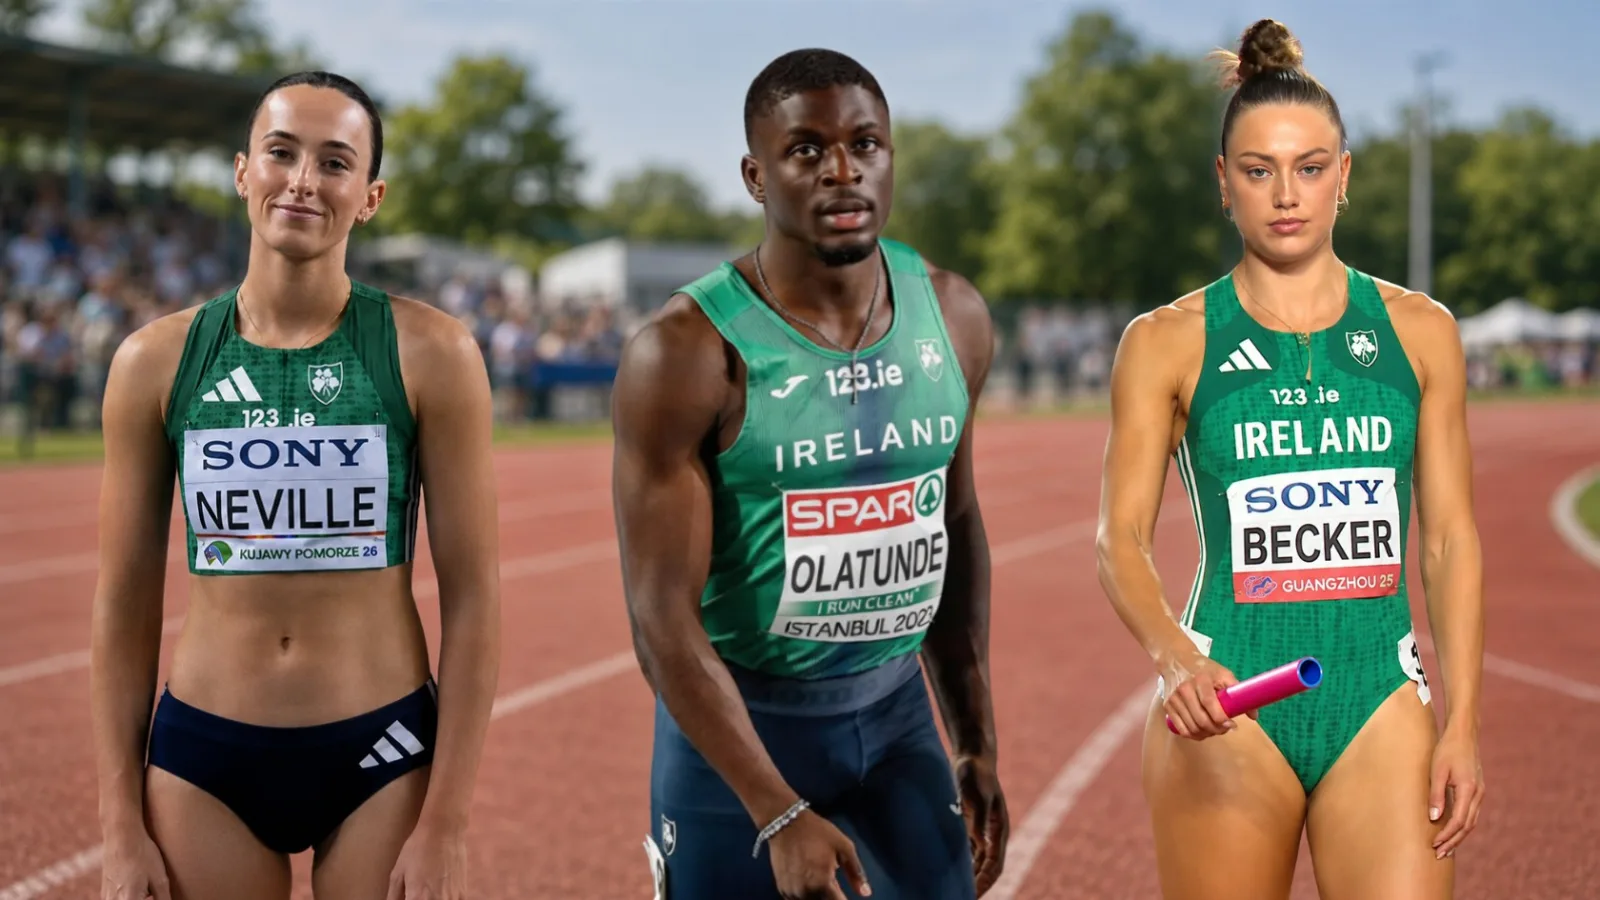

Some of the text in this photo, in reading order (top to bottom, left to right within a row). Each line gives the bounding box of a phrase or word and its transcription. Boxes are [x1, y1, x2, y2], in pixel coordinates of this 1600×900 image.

[202, 439, 369, 470] SONY
[776, 415, 957, 472] IRELAND
[1234, 416, 1392, 460] IRELAND
[196, 487, 376, 530] NEVILLE
[791, 489, 912, 530] SPAR
[1245, 480, 1384, 513] SONY
[239, 546, 378, 561] KUJAWY POMORZE 26
[1243, 520, 1394, 565] BECKER
[790, 531, 944, 594] OLATUNDE
[1282, 574, 1394, 593] GUANGZHOU 25
[827, 598, 862, 613] RUN
[784, 618, 890, 638] ISTANBUL
